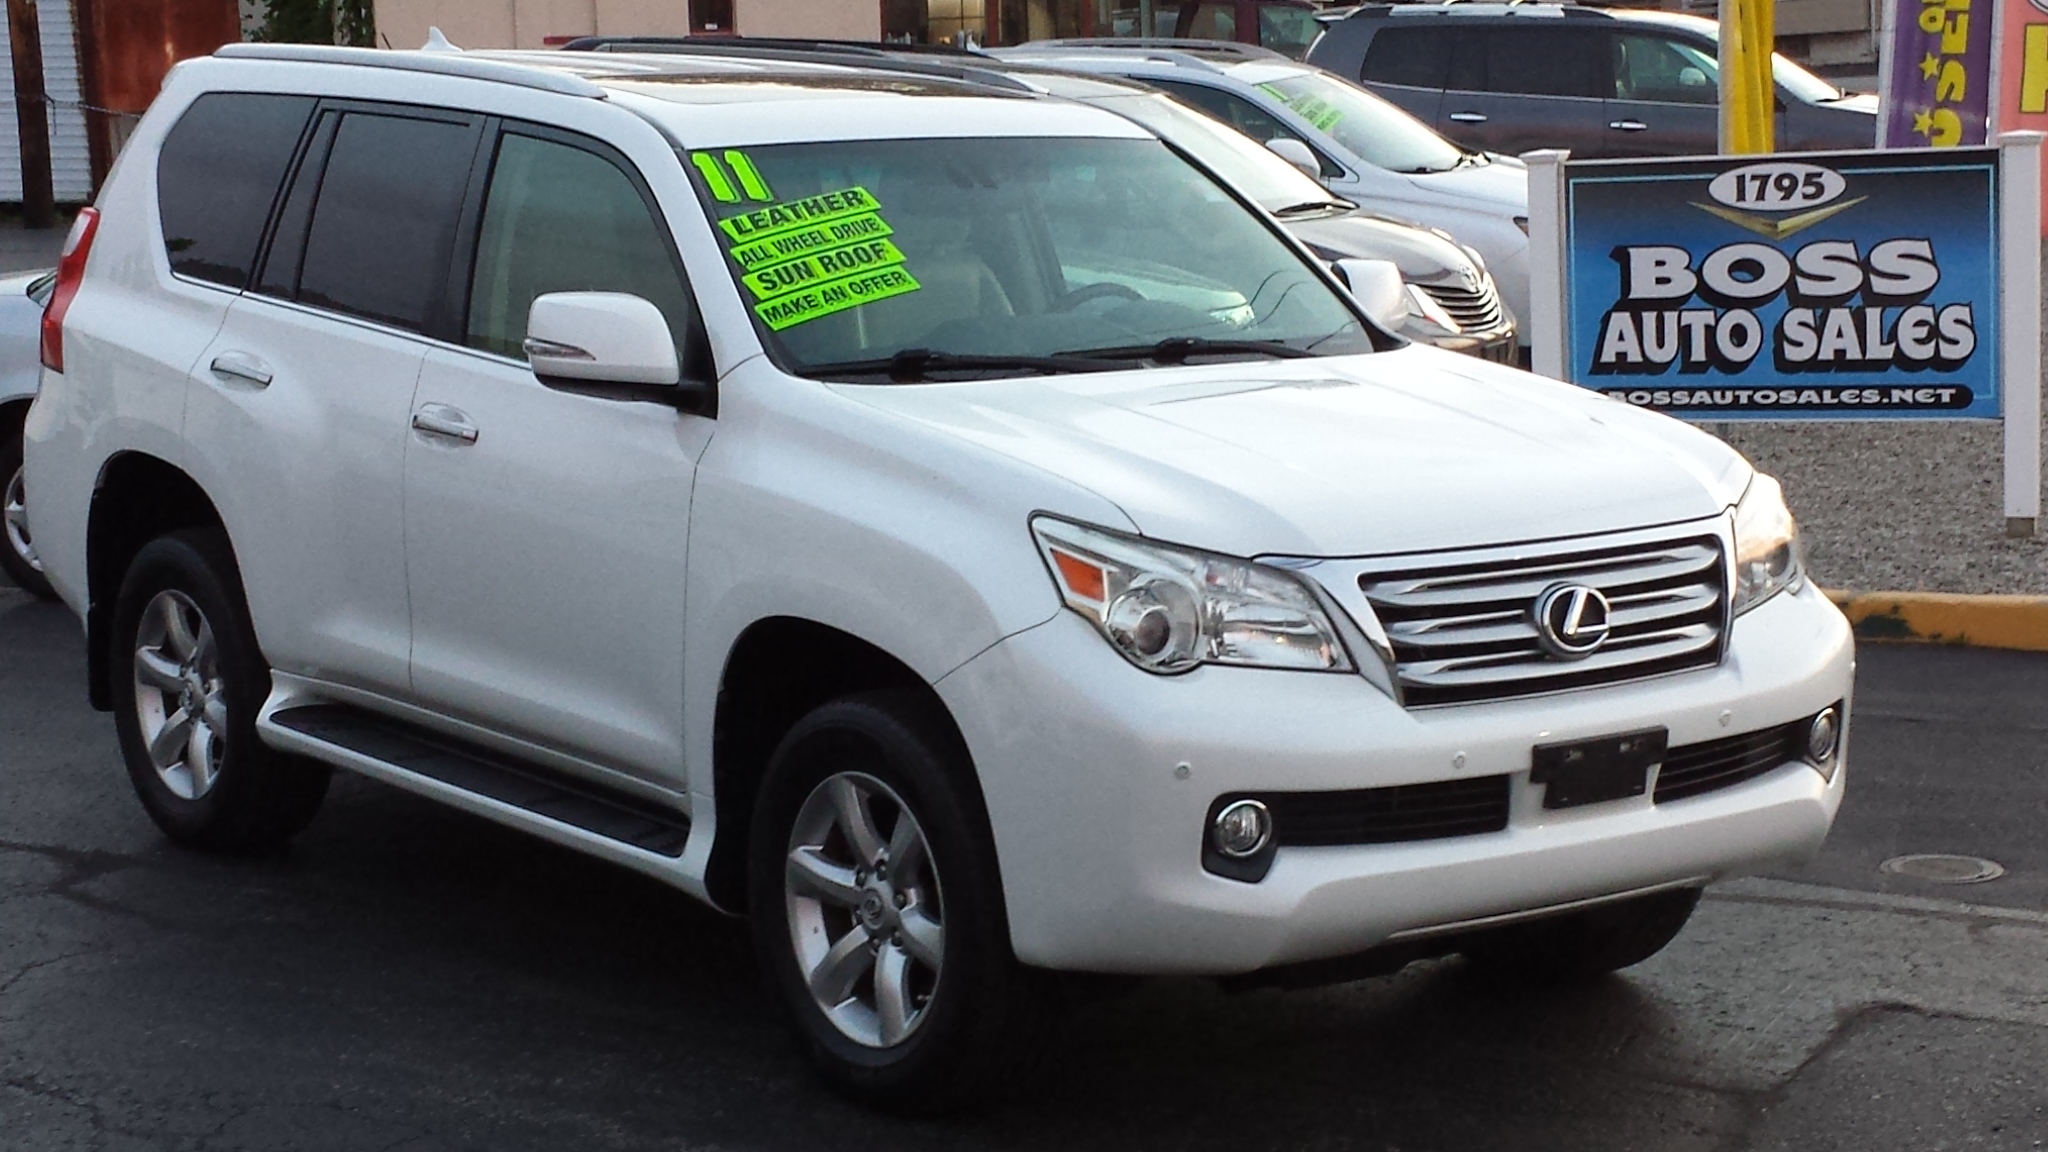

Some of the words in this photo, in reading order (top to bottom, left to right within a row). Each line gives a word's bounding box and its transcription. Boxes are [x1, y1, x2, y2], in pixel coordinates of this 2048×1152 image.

[691, 150, 775, 204] 11
[1734, 170, 1828, 203] 1795
[730, 189, 866, 236] LEATHER
[739, 244, 773, 268] ALL
[771, 229, 832, 257] WHEEL
[830, 216, 882, 241] DRIVE
[756, 262, 817, 293] SUN
[817, 241, 888, 275] ROOF
[762, 293, 820, 325] MAKE
[821, 284, 849, 306] AN
[848, 270, 908, 297] OFFER
[1613, 239, 1941, 304] BOSS
[1592, 306, 1764, 371] AUTO
[1776, 302, 1977, 370] SALES
[1607, 388, 1956, 406] BOSSAUTOSALES.NET
